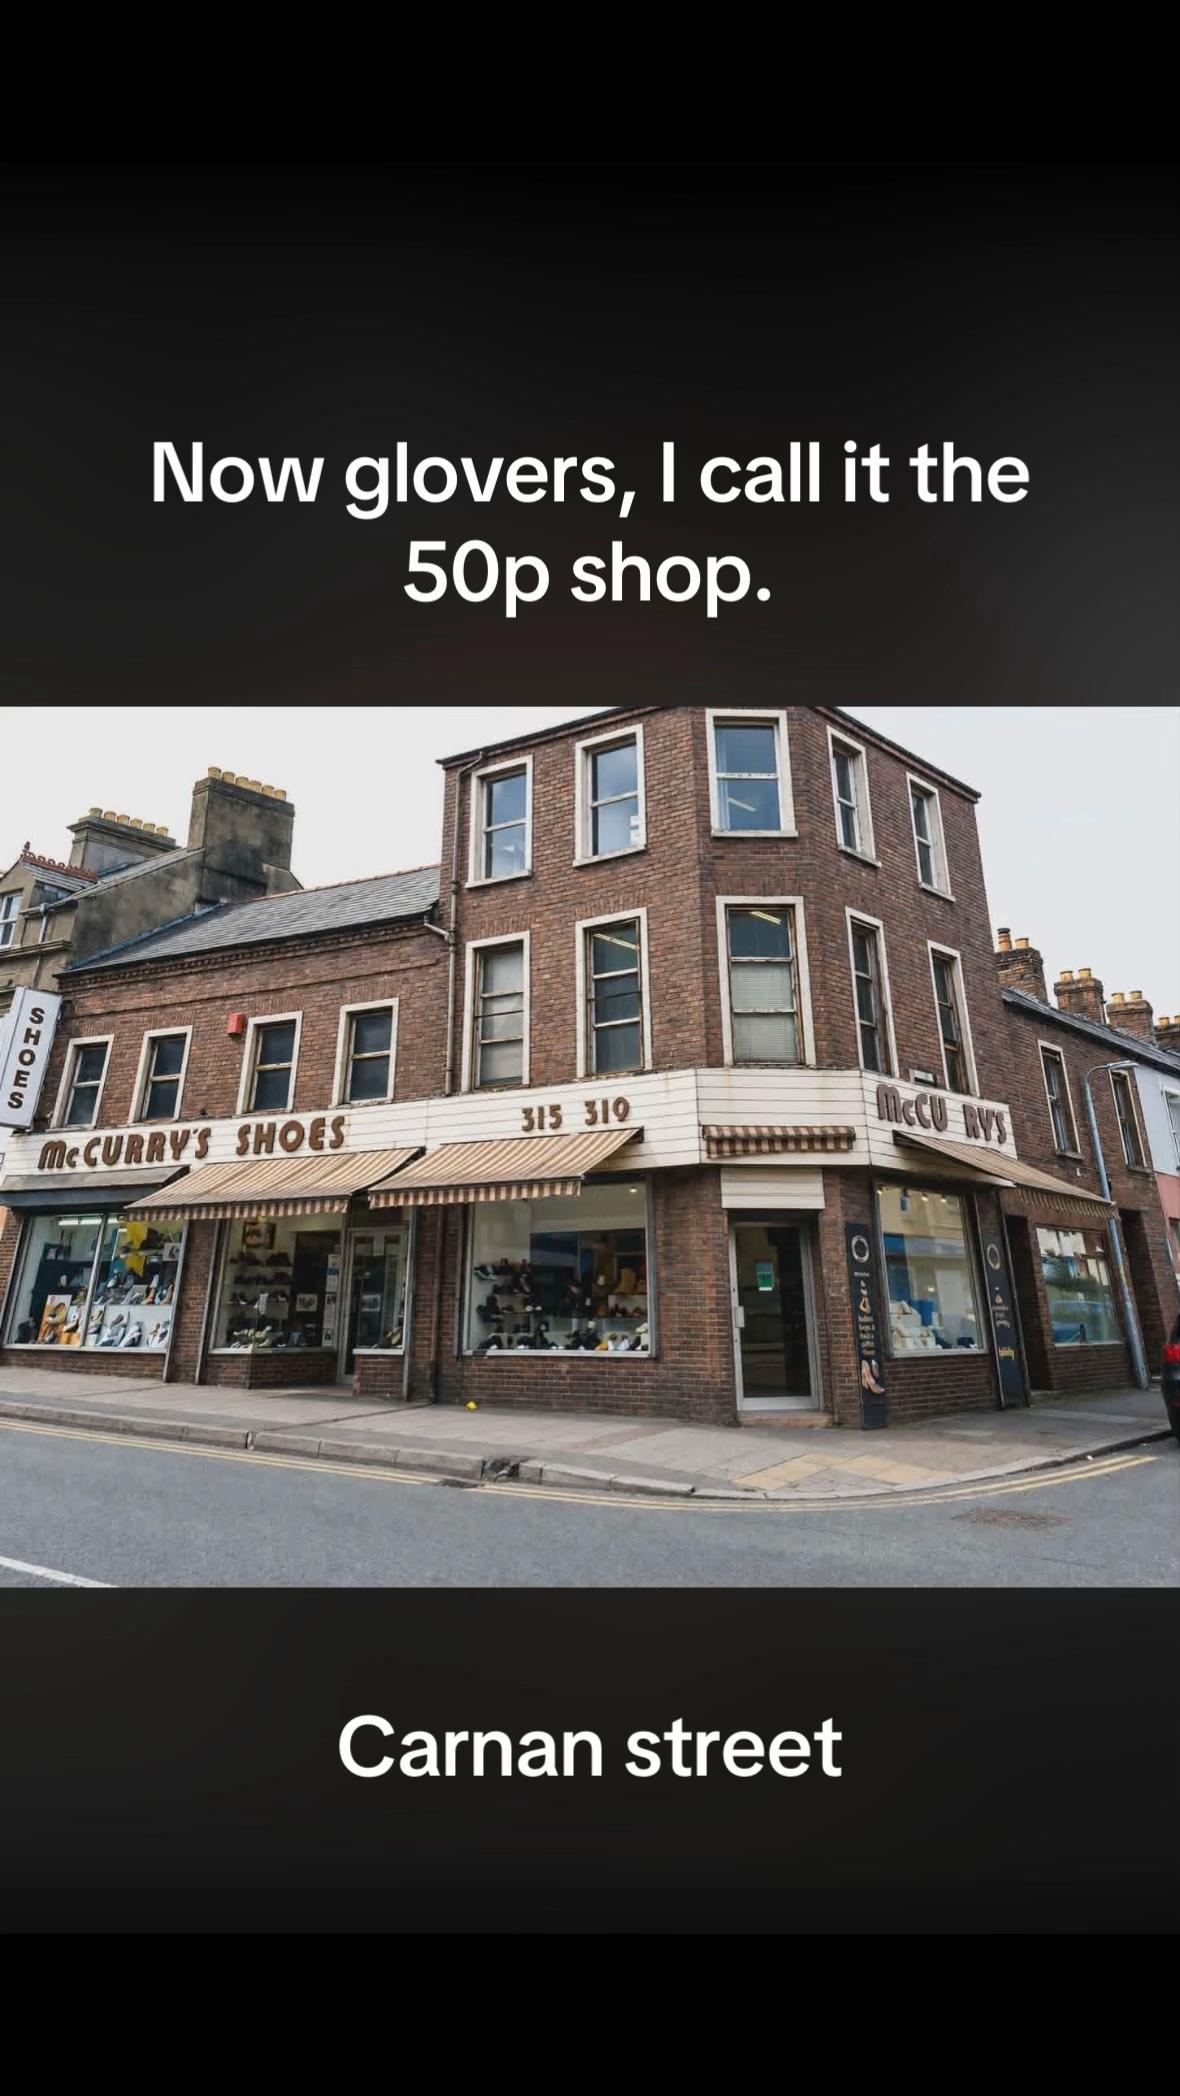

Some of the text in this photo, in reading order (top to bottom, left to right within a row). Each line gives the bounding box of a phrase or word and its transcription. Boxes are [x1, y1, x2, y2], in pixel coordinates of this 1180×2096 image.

[7, 1007, 46, 1110] SHOES
[37, 1115, 347, 1170] McCURRY'S SHOES
[521, 1103, 563, 1132] 315
